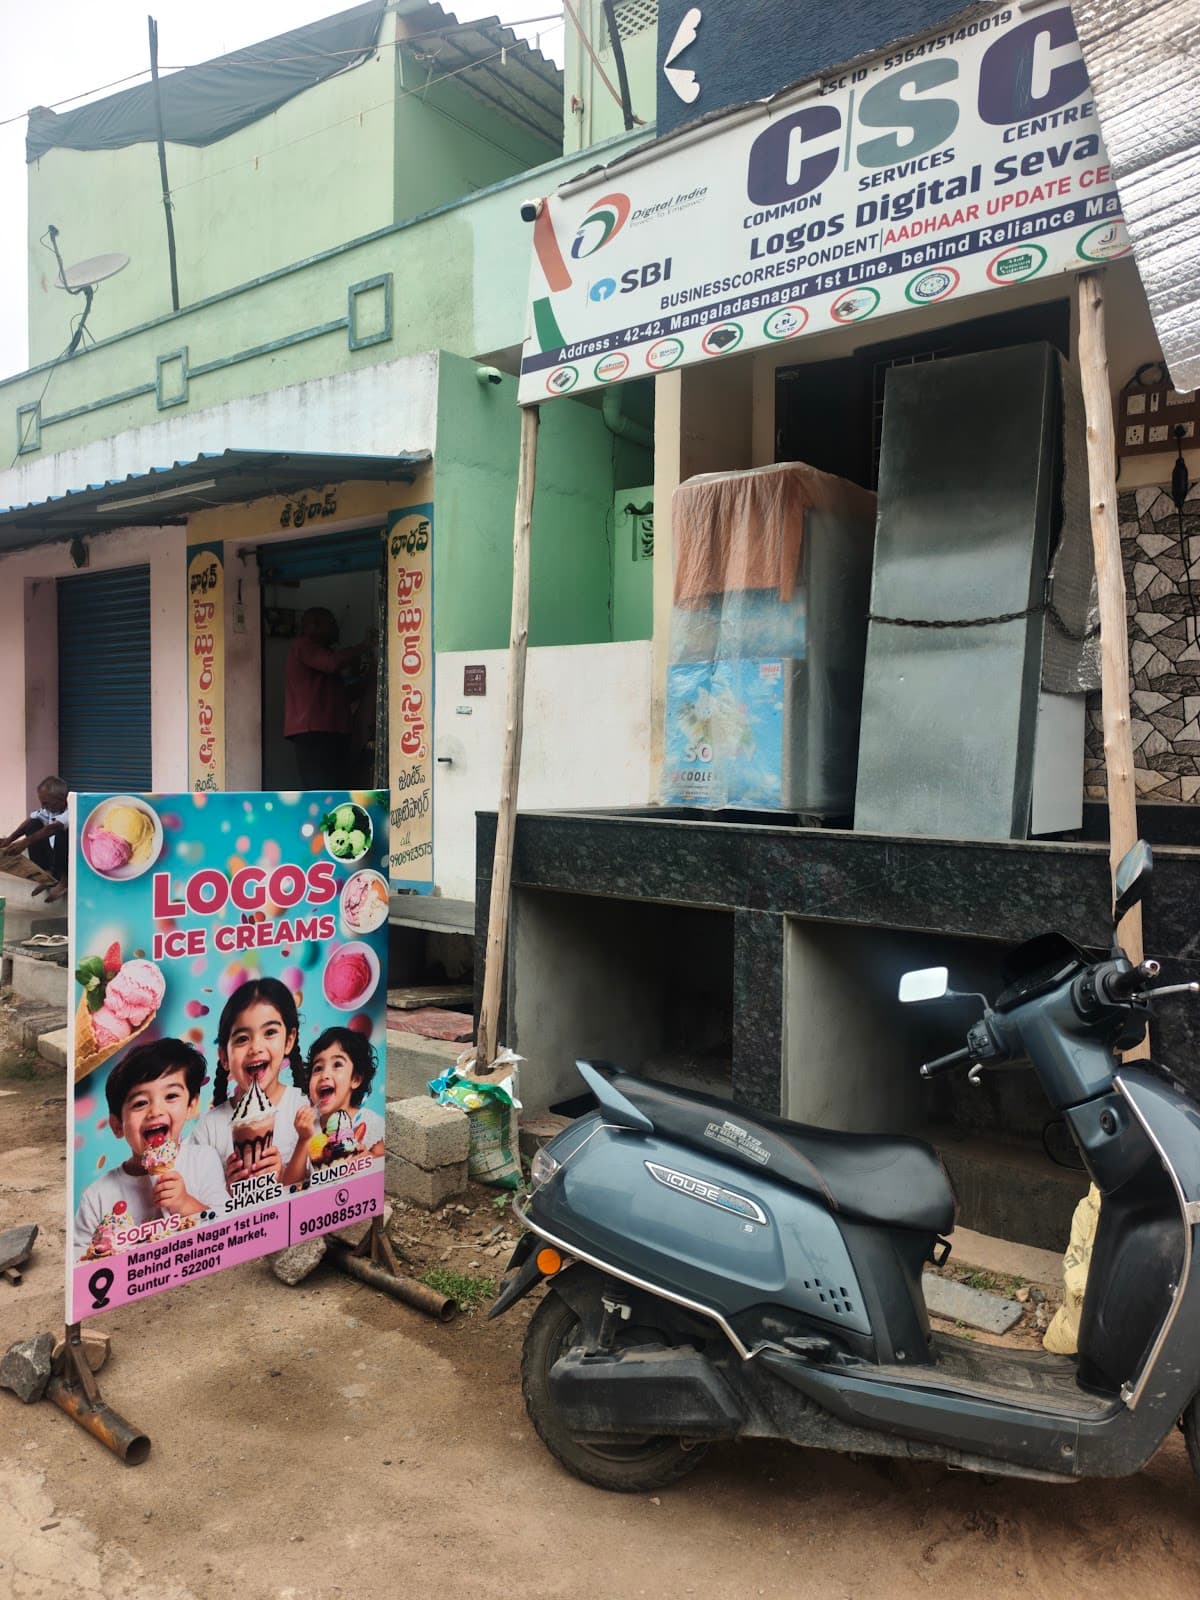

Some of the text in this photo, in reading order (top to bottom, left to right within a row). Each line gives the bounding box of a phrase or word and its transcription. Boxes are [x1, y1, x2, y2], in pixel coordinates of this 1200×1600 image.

[852, 69, 867, 83] ID
[884, 10, 1012, 70] 536475140019
[747, 6, 1091, 206] CSC
[1003, 102, 1094, 143] CENTRE
[858, 148, 955, 191] SERVICES
[631, 186, 708, 220] Digital India
[743, 192, 822, 229] COMMON
[750, 133, 1099, 261] Logos Digital Seva
[660, 234, 880, 310] BUSINESSCORRESPONDENT
[883, 204, 980, 246] AADHAAR
[986, 176, 1072, 216] UPDATE
[1079, 164, 1114, 189] CE
[558, 337, 610, 361] Address
[623, 321, 665, 342] 42-42,
[670, 282, 809, 331] Mangaladasnagar
[815, 272, 842, 290] 1st
[848, 258, 893, 284] Line,
[901, 236, 969, 268] behind
[978, 208, 1076, 248] Reliance
[619, 257, 673, 294] SBI
[153, 862, 337, 919] LOGOS
[153, 915, 336, 960] ICE CREAMS
[231, 1173, 276, 1196] THICK
[311, 1157, 373, 1185] SUNDAES
[225, 1185, 282, 1213] SHAKES
[299, 1198, 378, 1236] 9030885373
[116, 1215, 181, 1246] SOFTYS
[127, 1209, 279, 1266] Mangaldas Nagar 1st Line,
[744, 1224, 753, 1233] S
[127, 1227, 267, 1281] Behind Reliance Market,
[127, 1274, 170, 1296] Guntur
[181, 1255, 222, 1278] 522001
